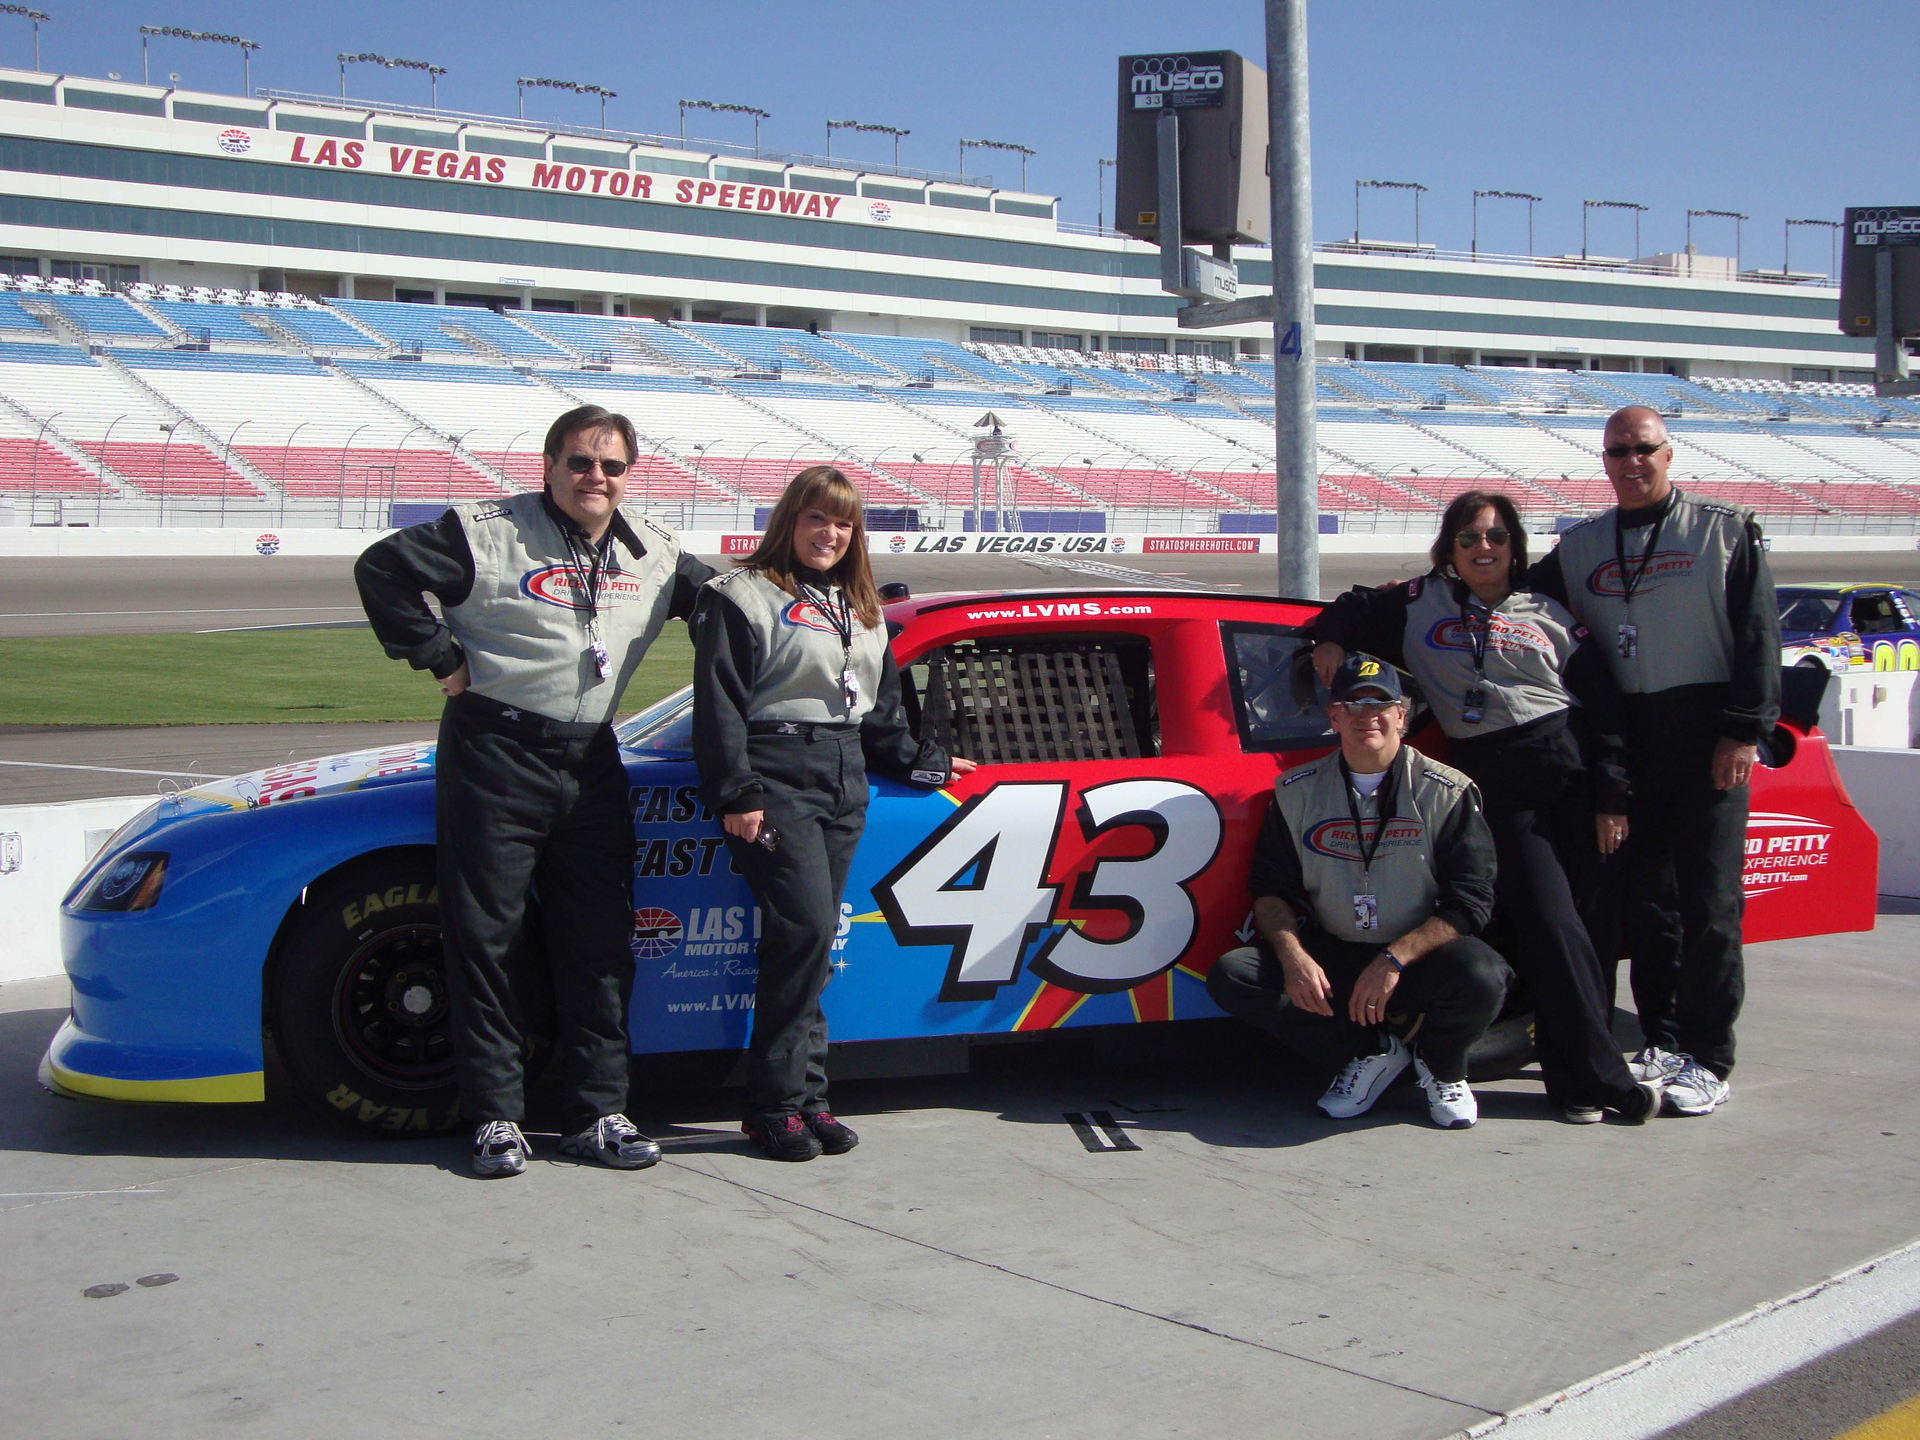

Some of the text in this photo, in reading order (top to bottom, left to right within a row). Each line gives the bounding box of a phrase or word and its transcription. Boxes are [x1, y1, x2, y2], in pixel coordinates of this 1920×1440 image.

[290, 136, 841, 219] LAS VEGAS MOTOR SPEEDWAY
[1280, 321, 1302, 363] 4
[730, 538, 762, 551] STRAT
[913, 536, 967, 553] LAS
[1149, 539, 1254, 551] STRATOSPHEREHOTEL.COM
[1656, 560, 1694, 572] PETTY
[553, 577, 641, 592] RICHRD PETTY
[599, 592, 642, 602] XPERIENCE
[966, 602, 1152, 620] www.LVMS.com
[1511, 629, 1551, 648] PETTY
[1384, 828, 1422, 839] PETTY
[1366, 839, 1423, 851] EPERIENCE
[1766, 833, 1831, 854] PETTY
[634, 836, 726, 878] FAST
[1743, 853, 1829, 870] XPERIENCE
[875, 777, 1224, 996] 43
[1741, 871, 1809, 885] EPETTY.com
[687, 906, 745, 941] LAS
[684, 942, 750, 956] MOTOR
[660, 960, 719, 979] America's
[668, 993, 756, 1013] www.LVM
